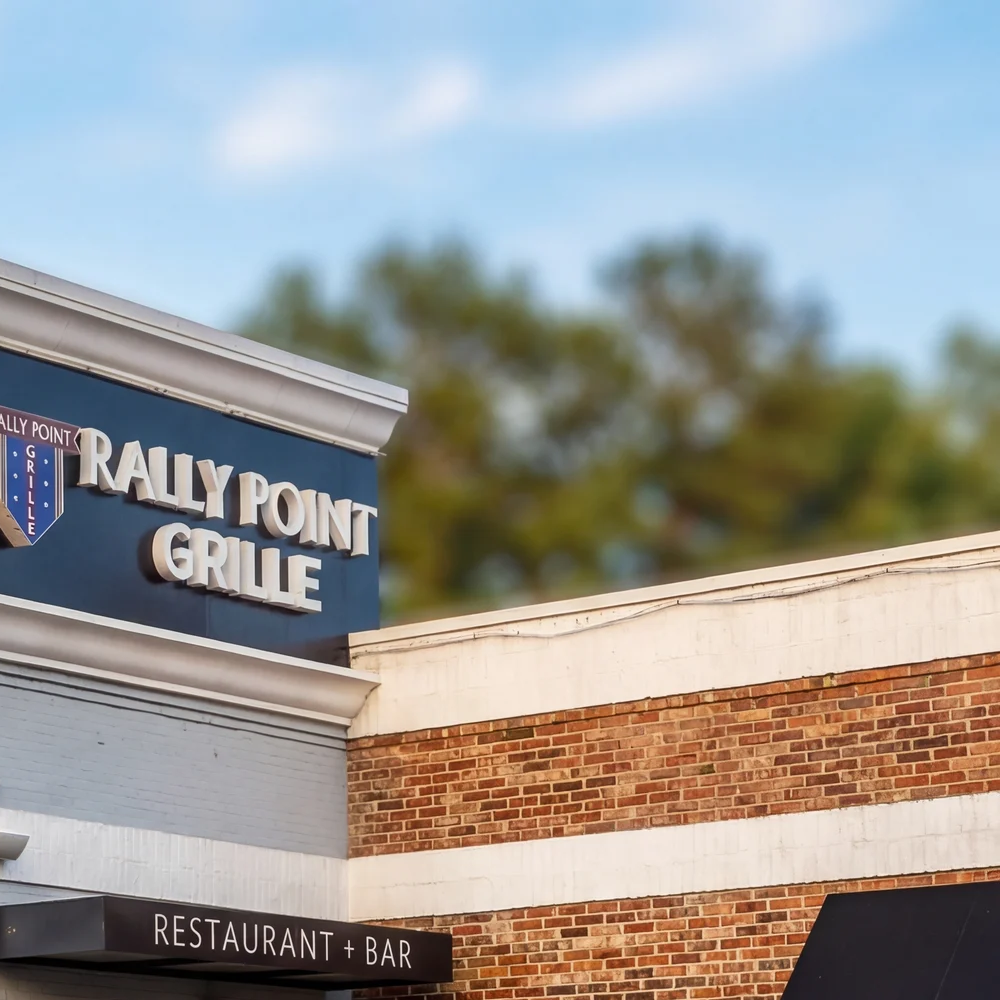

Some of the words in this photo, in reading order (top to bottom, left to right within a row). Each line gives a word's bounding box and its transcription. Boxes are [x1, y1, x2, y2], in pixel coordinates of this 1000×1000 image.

[32, 421, 71, 446] POINT
[26, 445, 36, 536] GRILLE
[77, 427, 234, 519] RALLY
[239, 471, 378, 557] POINT
[152, 522, 322, 613] GRILLE
[154, 913, 334, 961] RESTAURANT
[343, 939, 355, 959] +
[365, 936, 412, 969] BAR
